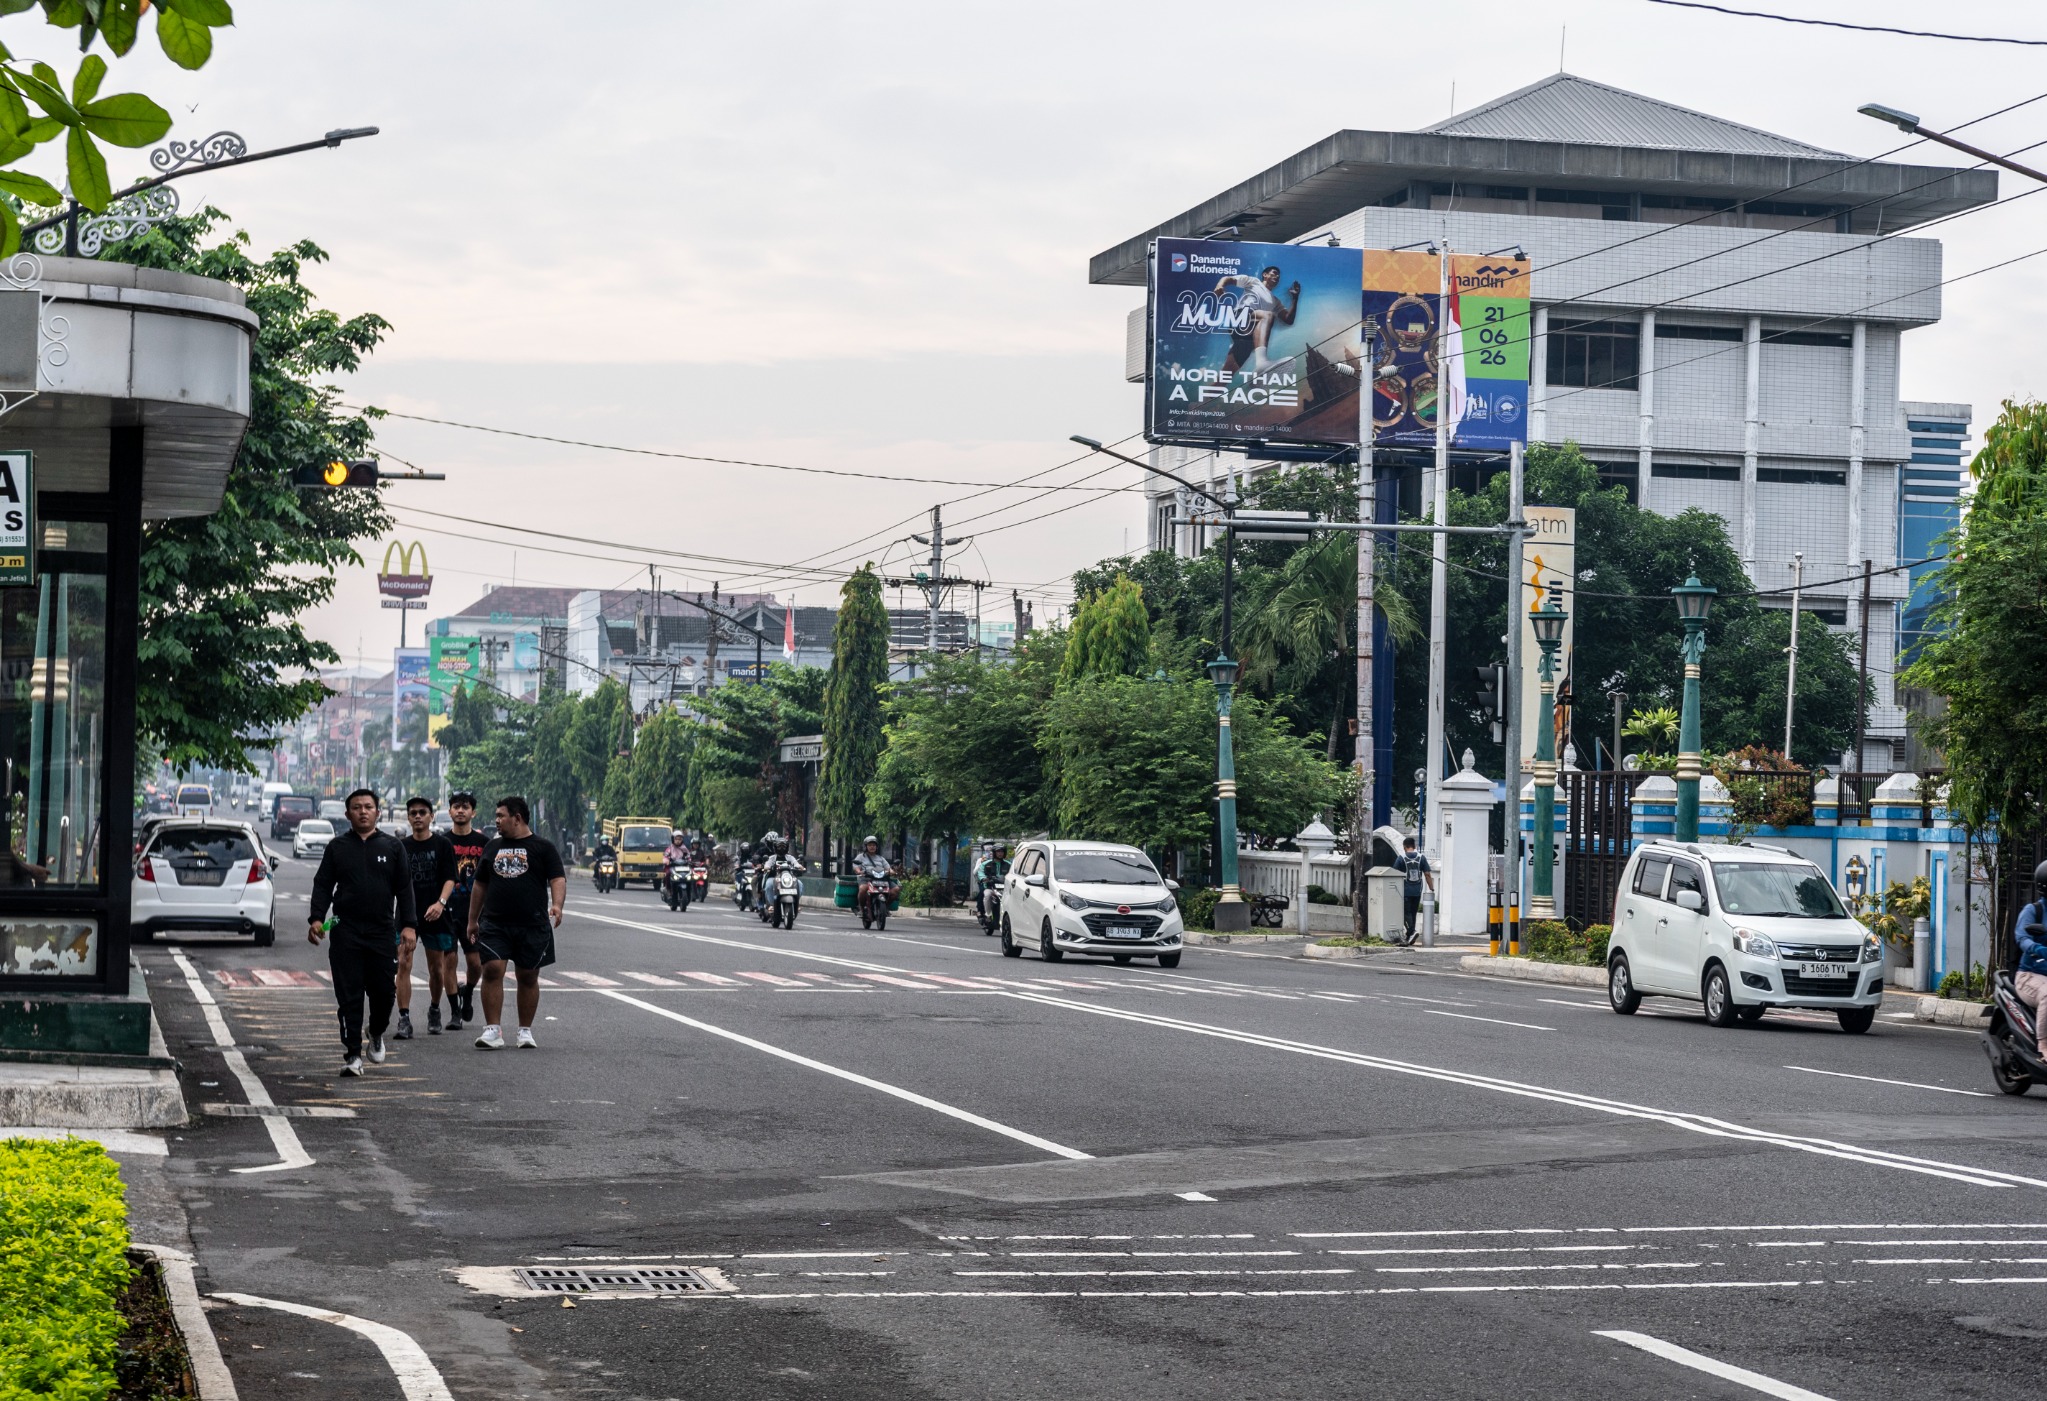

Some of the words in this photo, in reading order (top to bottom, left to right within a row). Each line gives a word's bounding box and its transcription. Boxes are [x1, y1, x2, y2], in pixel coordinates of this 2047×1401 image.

[1190, 254, 1241, 266] Danantara
[1190, 264, 1238, 275] Indonesia
[1181, 303, 1249, 328] MJM
[1484, 306, 1504, 322] 21
[1479, 328, 1508, 345] 06
[1480, 349, 1507, 365] 26
[1170, 367, 1233, 384] MORE
[1238, 371, 1297, 387] THAN
[1168, 384, 1189, 402] A
[1198, 385, 1298, 407] RACE
[1529, 516, 1567, 534] atm
[9, 558, 22, 566] m
[9, 575, 27, 583] Jetis)
[380, 581, 430, 590] McDonald's
[1801, 963, 1807, 973] B
[1810, 964, 1830, 973] 1606
[1831, 964, 1846, 974] TYX
